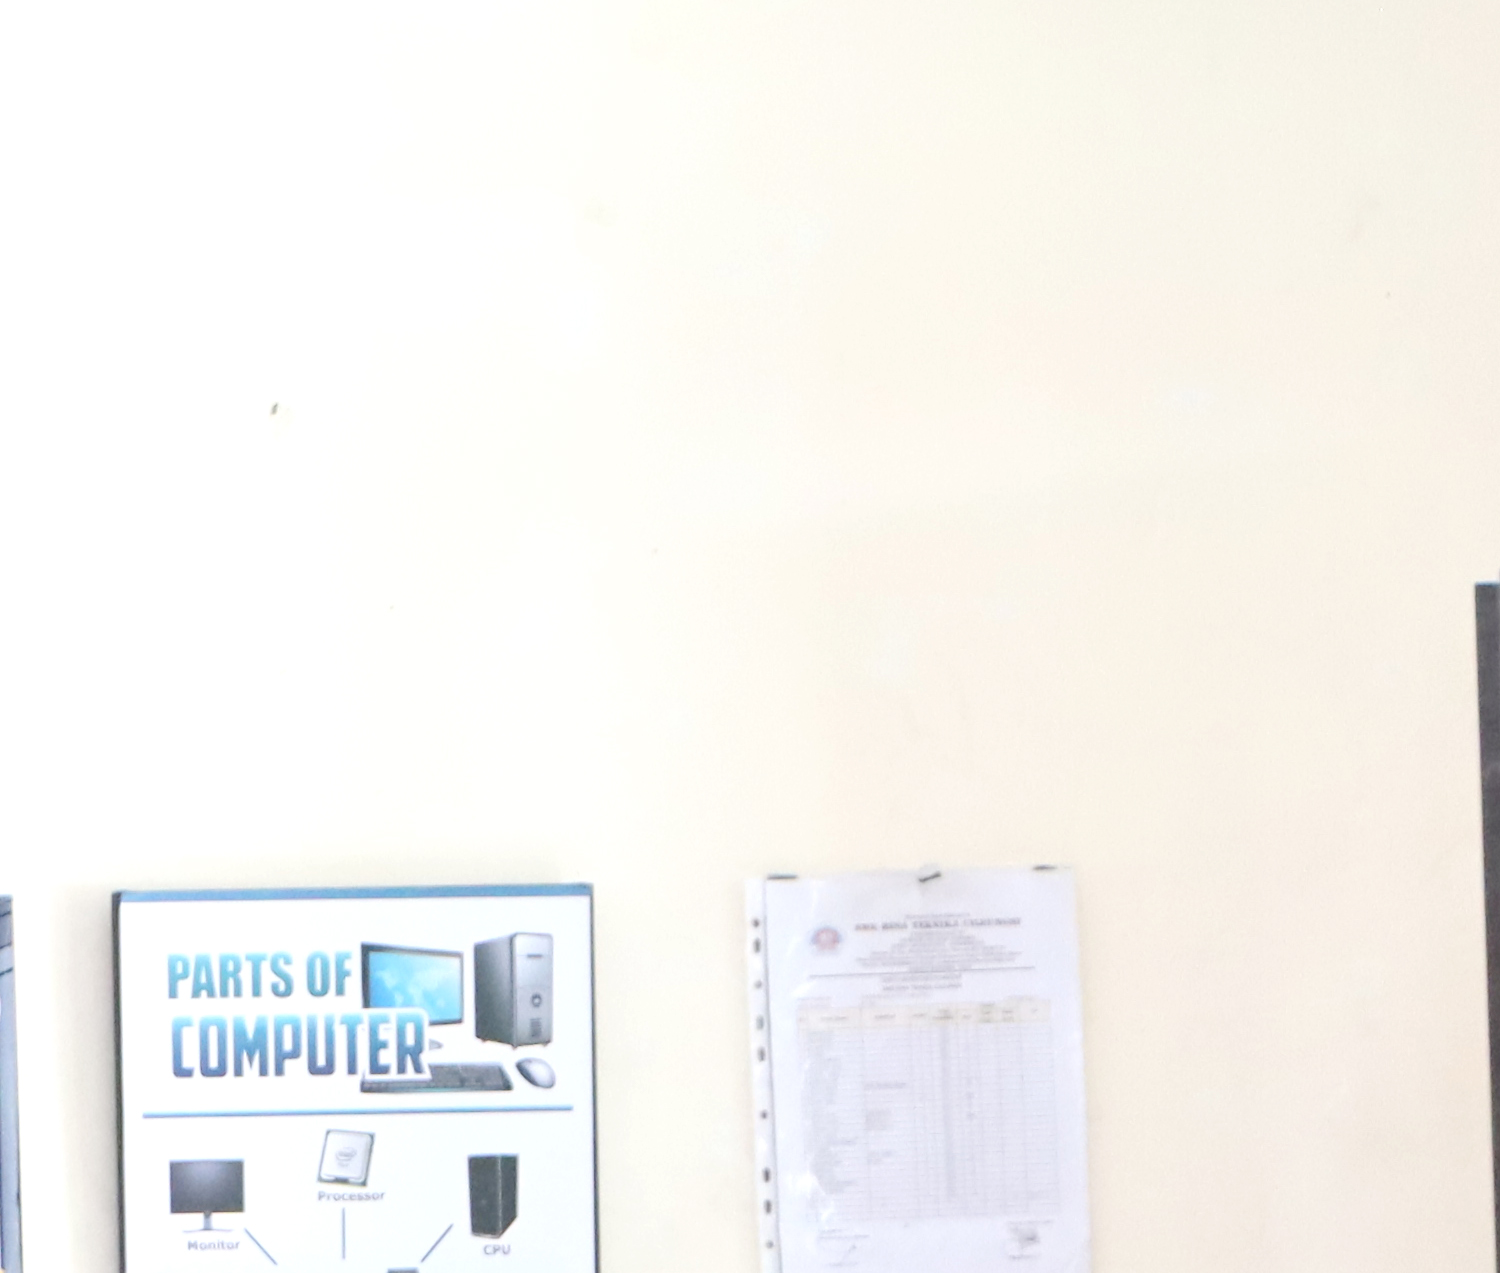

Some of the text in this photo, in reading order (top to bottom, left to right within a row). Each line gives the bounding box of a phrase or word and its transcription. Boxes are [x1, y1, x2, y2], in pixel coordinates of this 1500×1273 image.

[167, 950, 352, 999] PARTS OF
[172, 1013, 425, 1078] COMPUTER
[317, 1190, 385, 1202] Processor
[187, 1239, 241, 1251] Monitor
[483, 1244, 511, 1256] CPU
